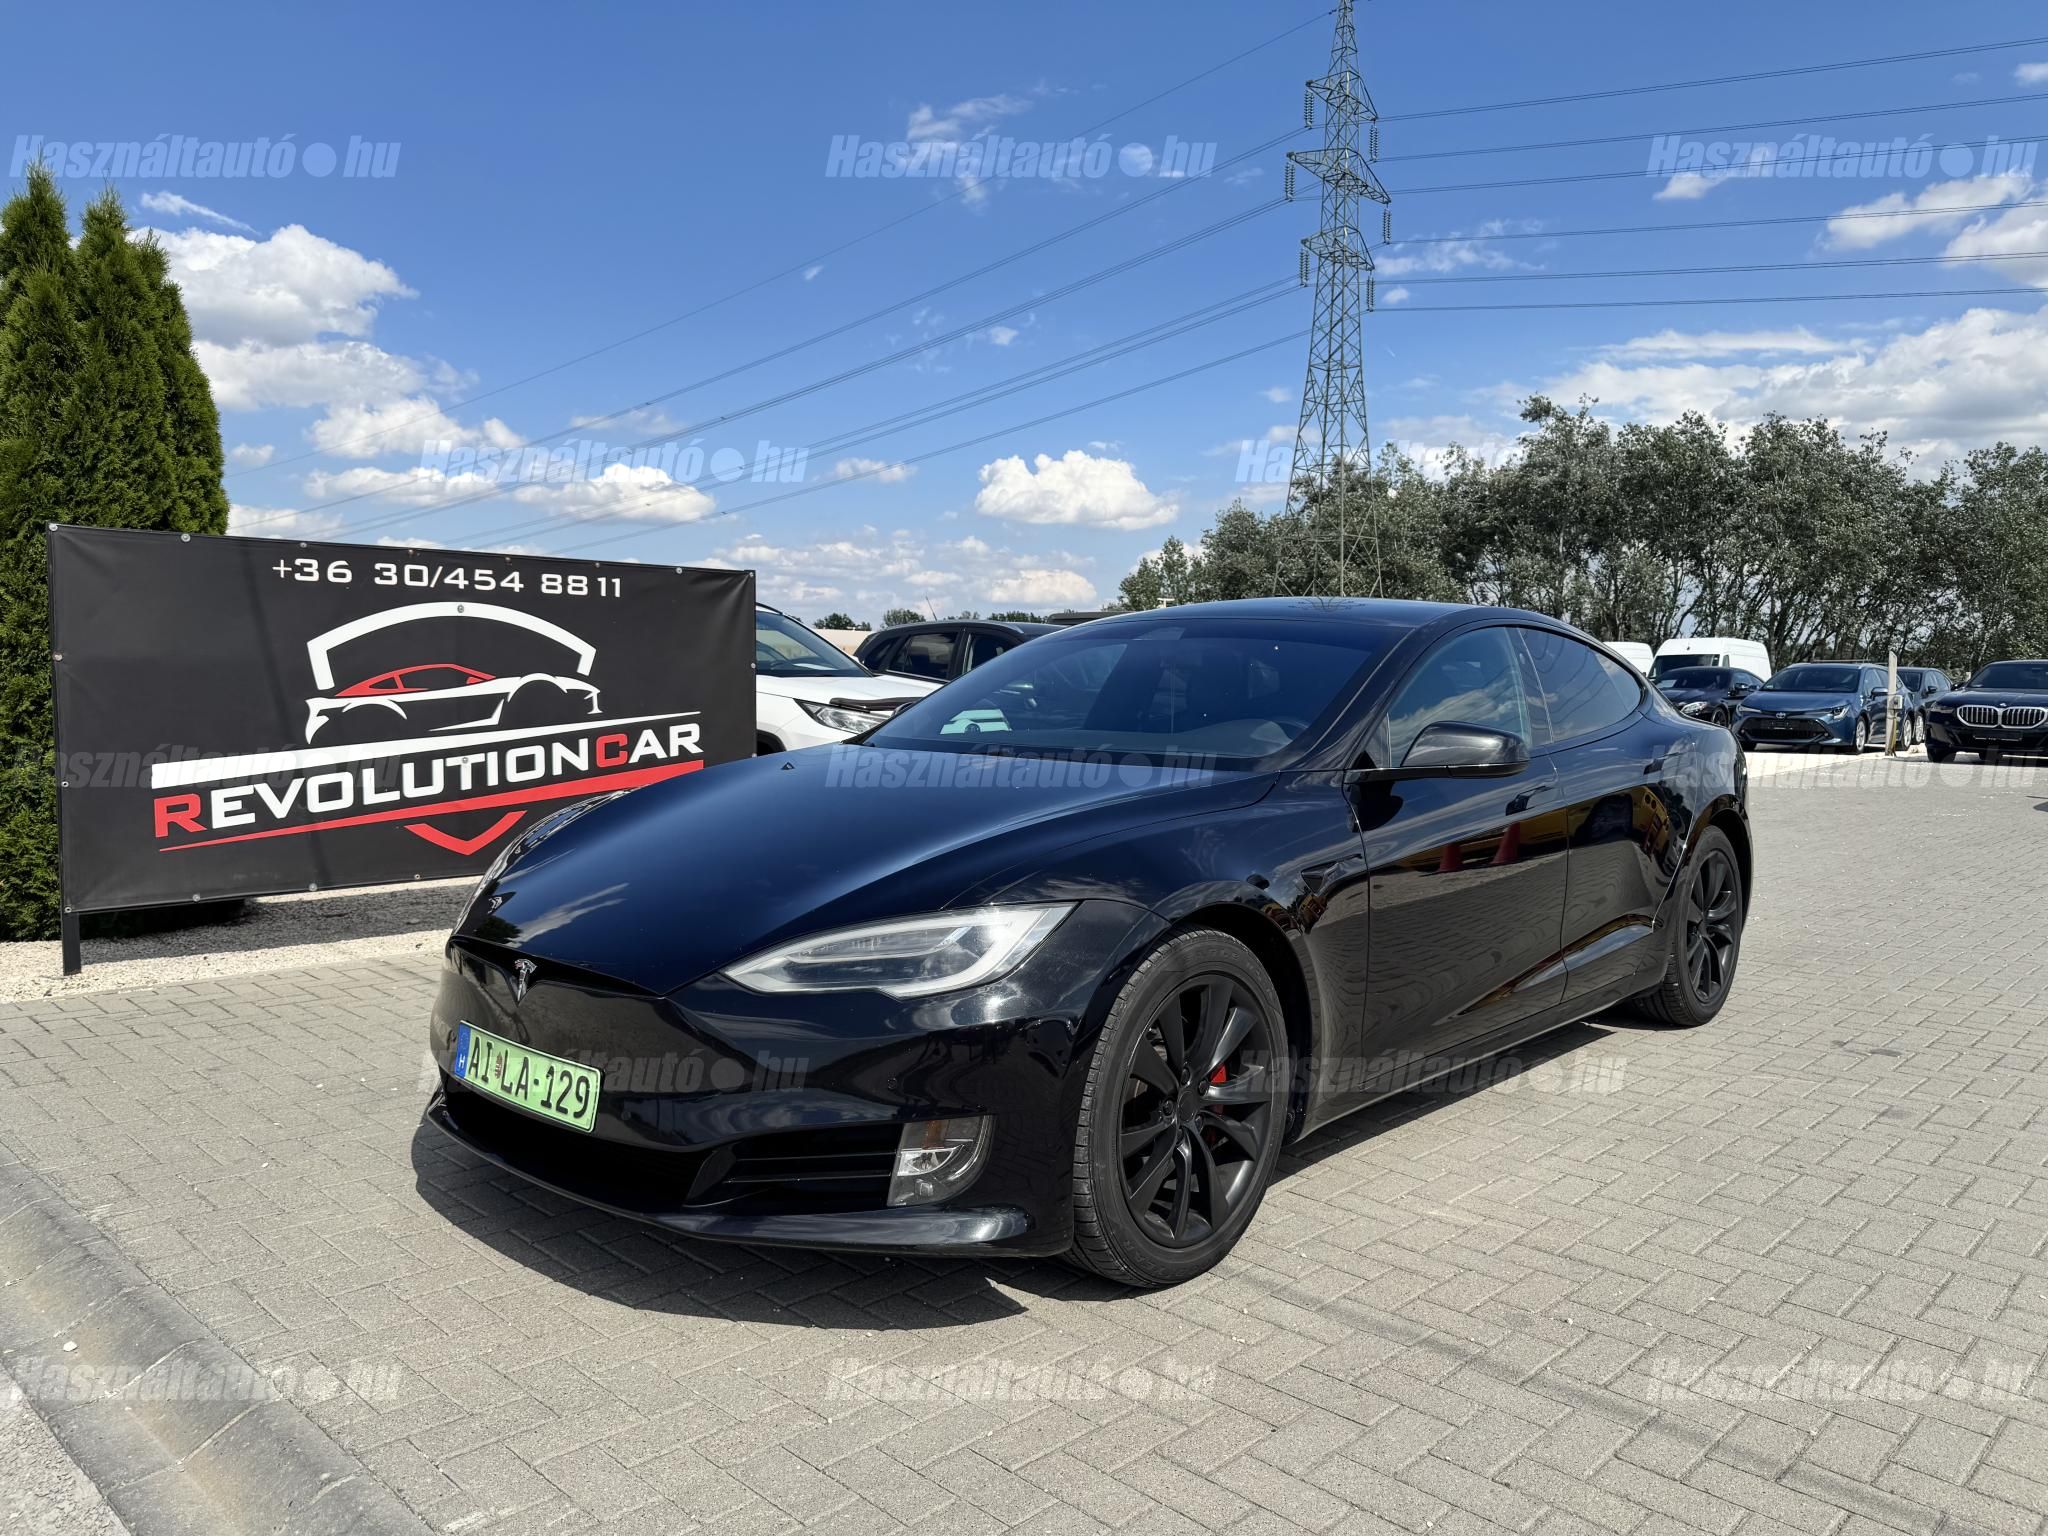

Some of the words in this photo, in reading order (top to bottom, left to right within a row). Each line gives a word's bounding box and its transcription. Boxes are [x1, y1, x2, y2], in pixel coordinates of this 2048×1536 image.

[273, 558, 352, 583] +36
[374, 562, 524, 593] 30/454
[540, 573, 622, 598] 8811
[154, 722, 704, 838] REVOLUTIONCAR
[458, 1053, 466, 1070] H
[468, 1036, 494, 1084] AI
[500, 1049, 591, 1119] LA-129
